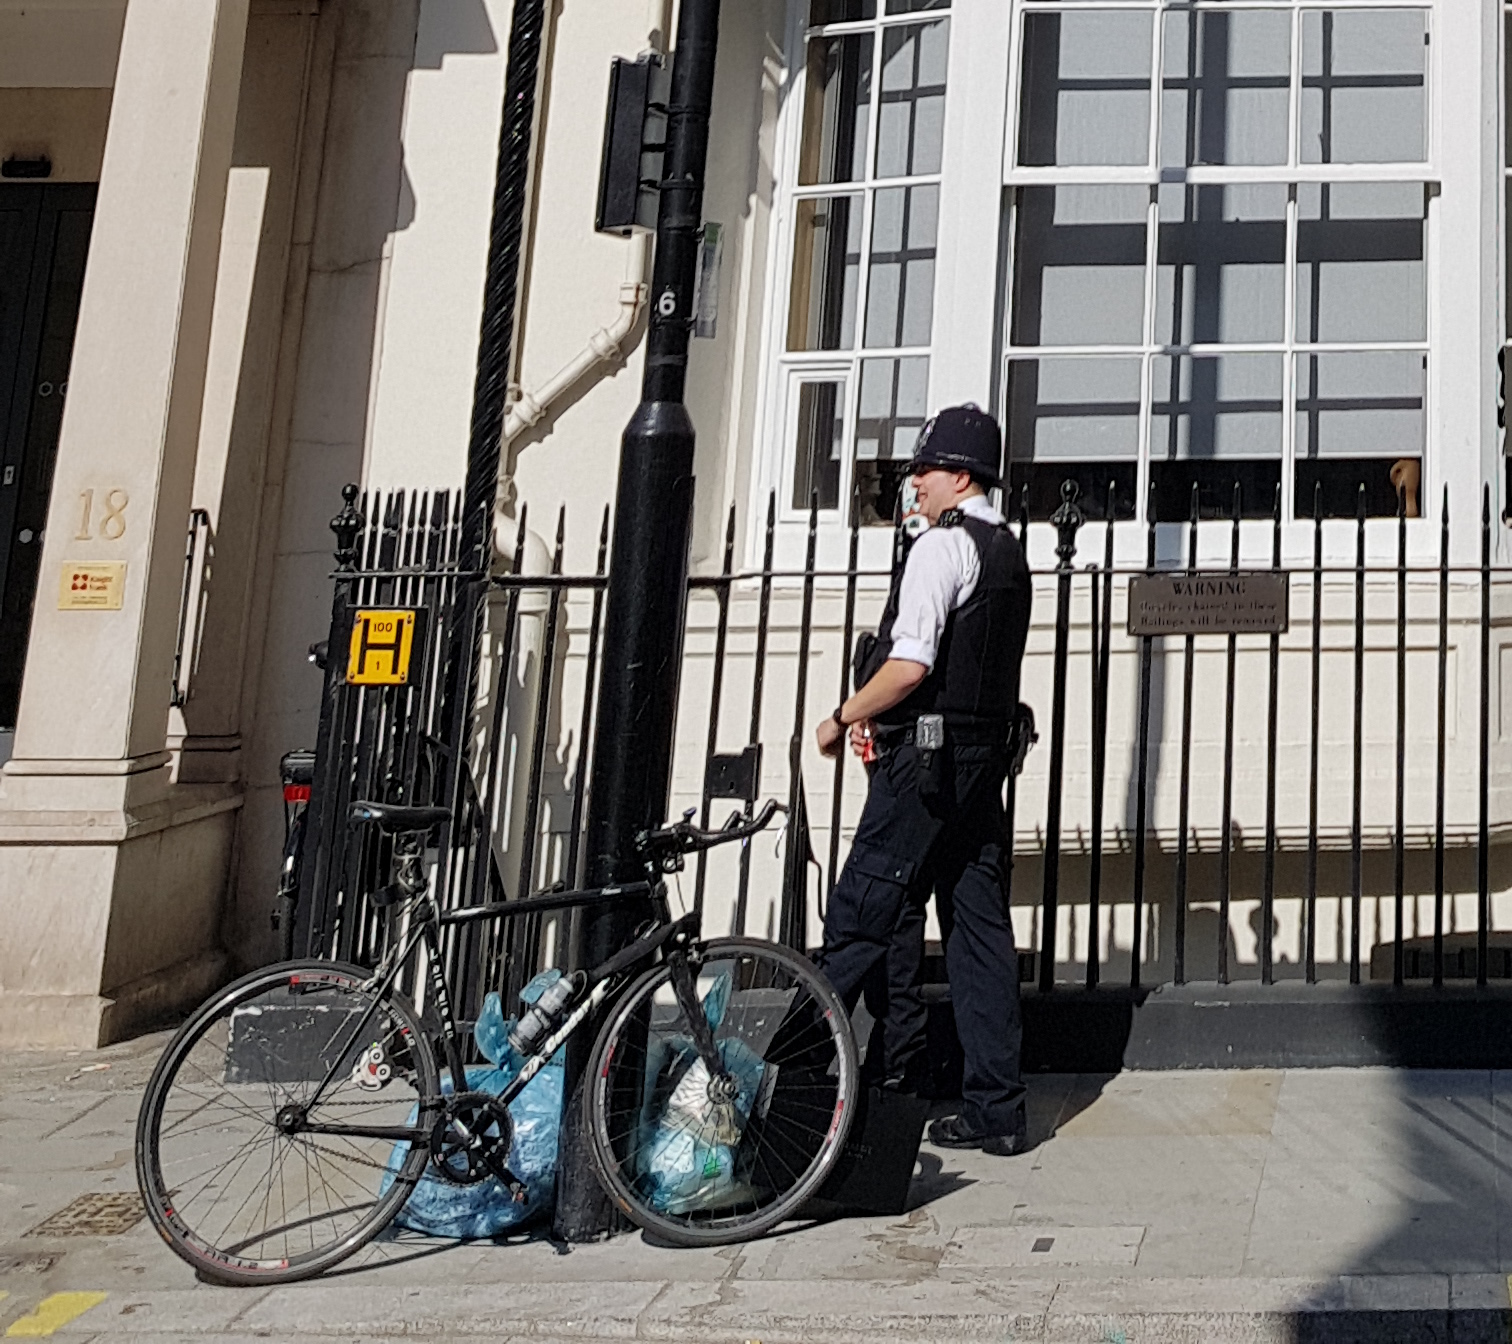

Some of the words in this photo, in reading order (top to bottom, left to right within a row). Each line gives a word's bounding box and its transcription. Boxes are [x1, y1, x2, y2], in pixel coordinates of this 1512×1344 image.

[654, 291, 676, 316] 6
[75, 488, 129, 541] 18
[1172, 581, 1246, 596] WARNING
[373, 622, 393, 632] 100
[357, 618, 404, 675] H
[376, 661, 380, 670] 1
